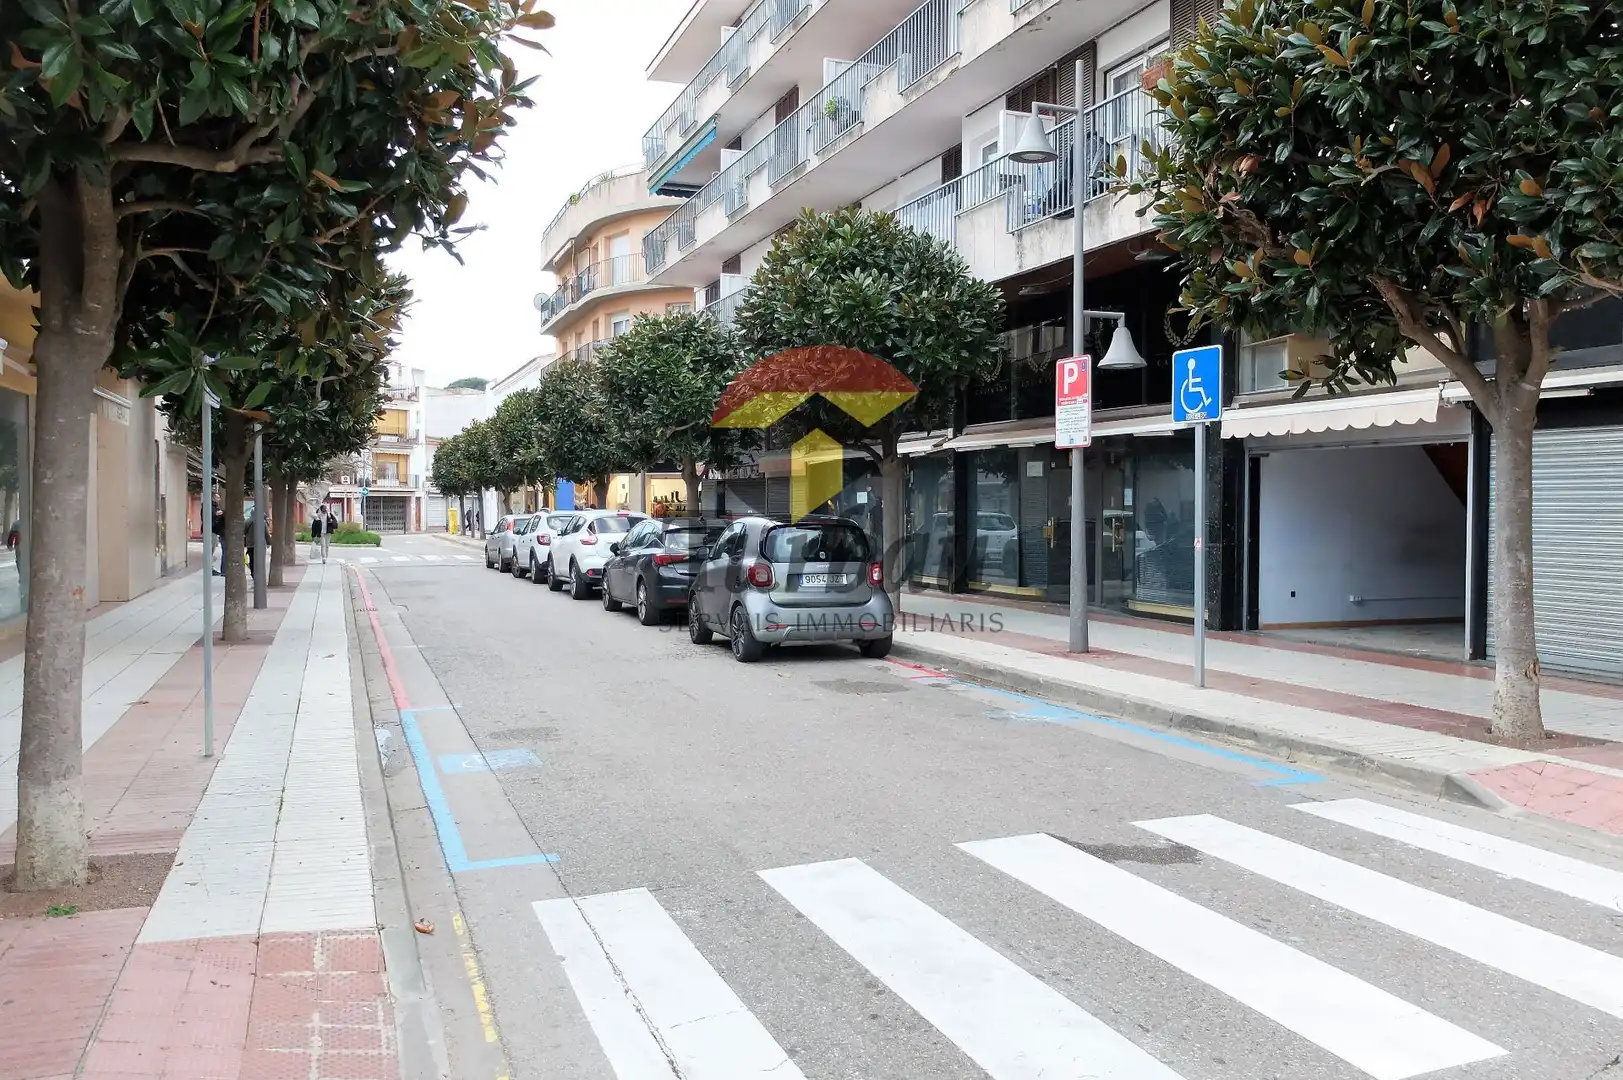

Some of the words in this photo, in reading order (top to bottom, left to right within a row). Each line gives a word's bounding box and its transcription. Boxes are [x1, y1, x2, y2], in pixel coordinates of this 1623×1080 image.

[1063, 362, 1079, 395] P
[805, 574, 827, 584] 9054
[829, 574, 845, 584] JZT
